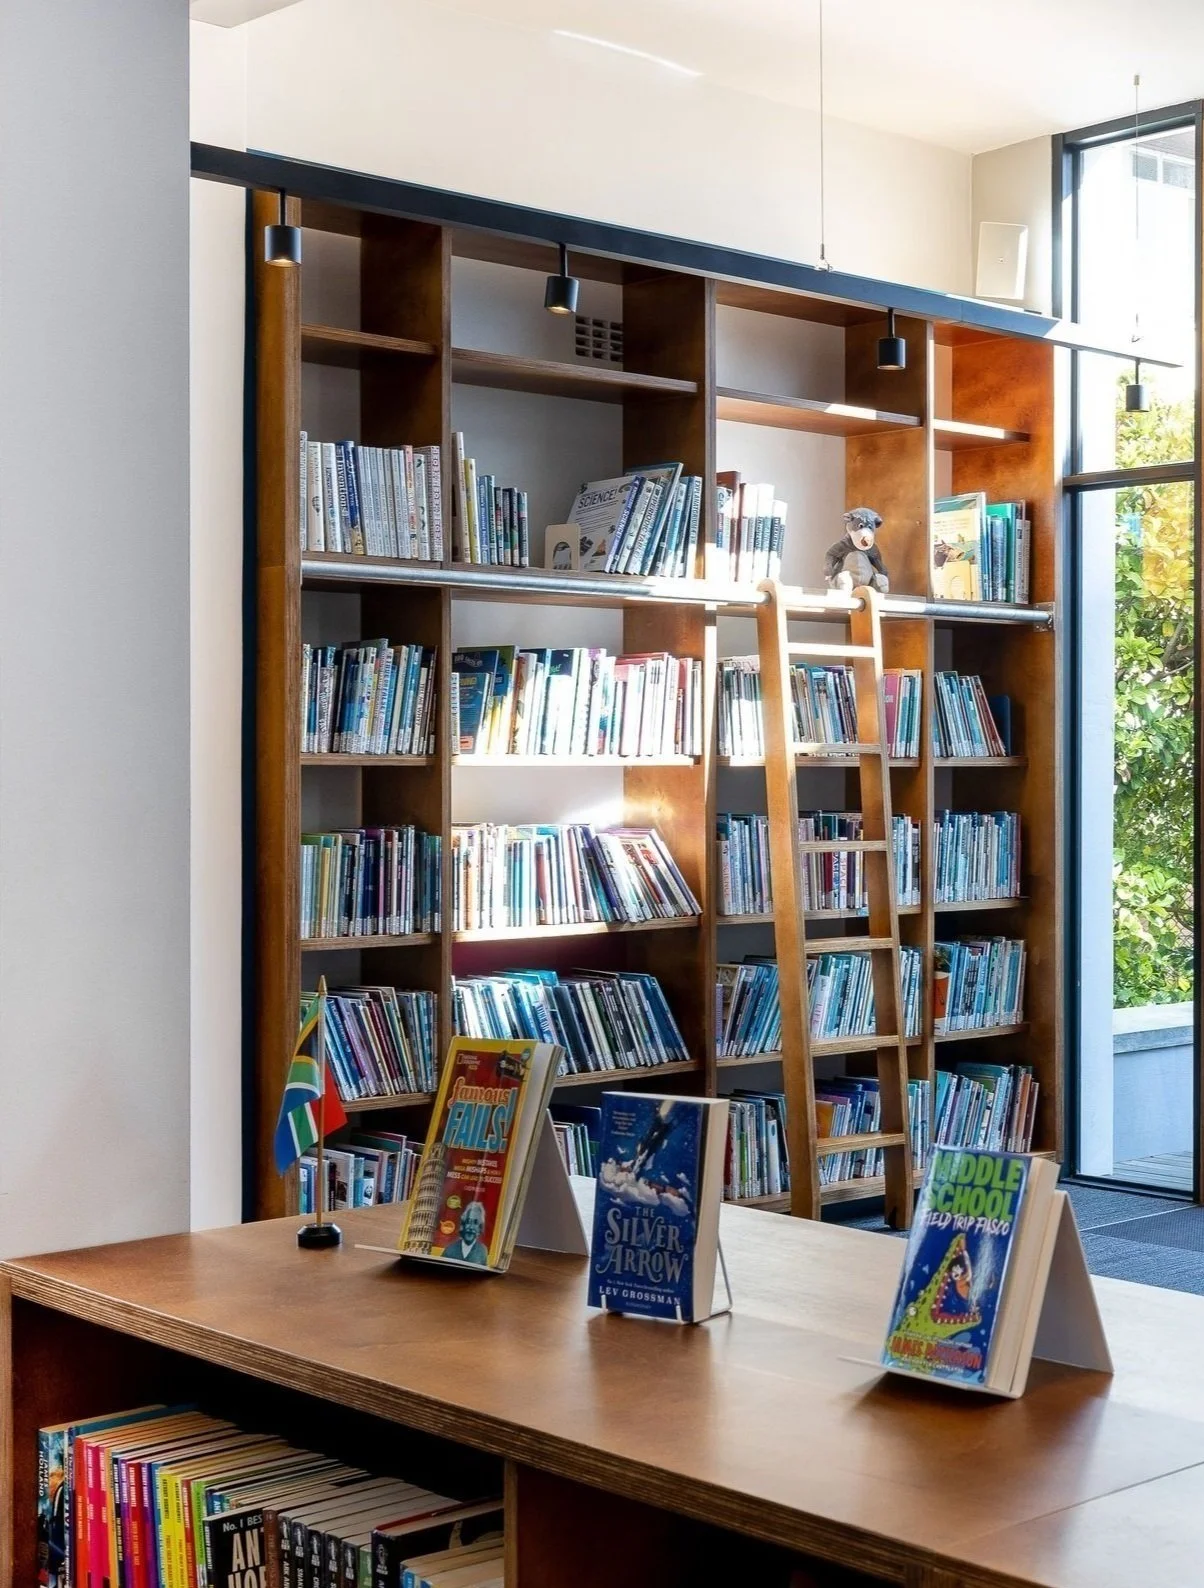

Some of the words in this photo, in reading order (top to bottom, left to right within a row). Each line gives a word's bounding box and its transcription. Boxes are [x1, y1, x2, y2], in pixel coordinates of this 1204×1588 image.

[337, 459, 348, 510] Inventions
[578, 489, 618, 508] SCIENCE!
[616, 510, 629, 538] SCIENCE!
[442, 1087, 518, 1153] FAILS!
[934, 1150, 1024, 1191] MIDDLE
[634, 1206, 656, 1219] THE
[920, 1207, 951, 1228] FIELD
[952, 1215, 974, 1231] TRIP
[927, 1183, 1014, 1223] SCHOOL
[605, 1207, 684, 1254] SILVER
[595, 1244, 688, 1284] ARROW
[598, 1285, 619, 1296] LEV
[622, 1289, 681, 1305] GROSSMAN
[222, 1521, 238, 1532] No.
[247, 1515, 262, 1526] BES
[232, 1528, 264, 1572] AN
